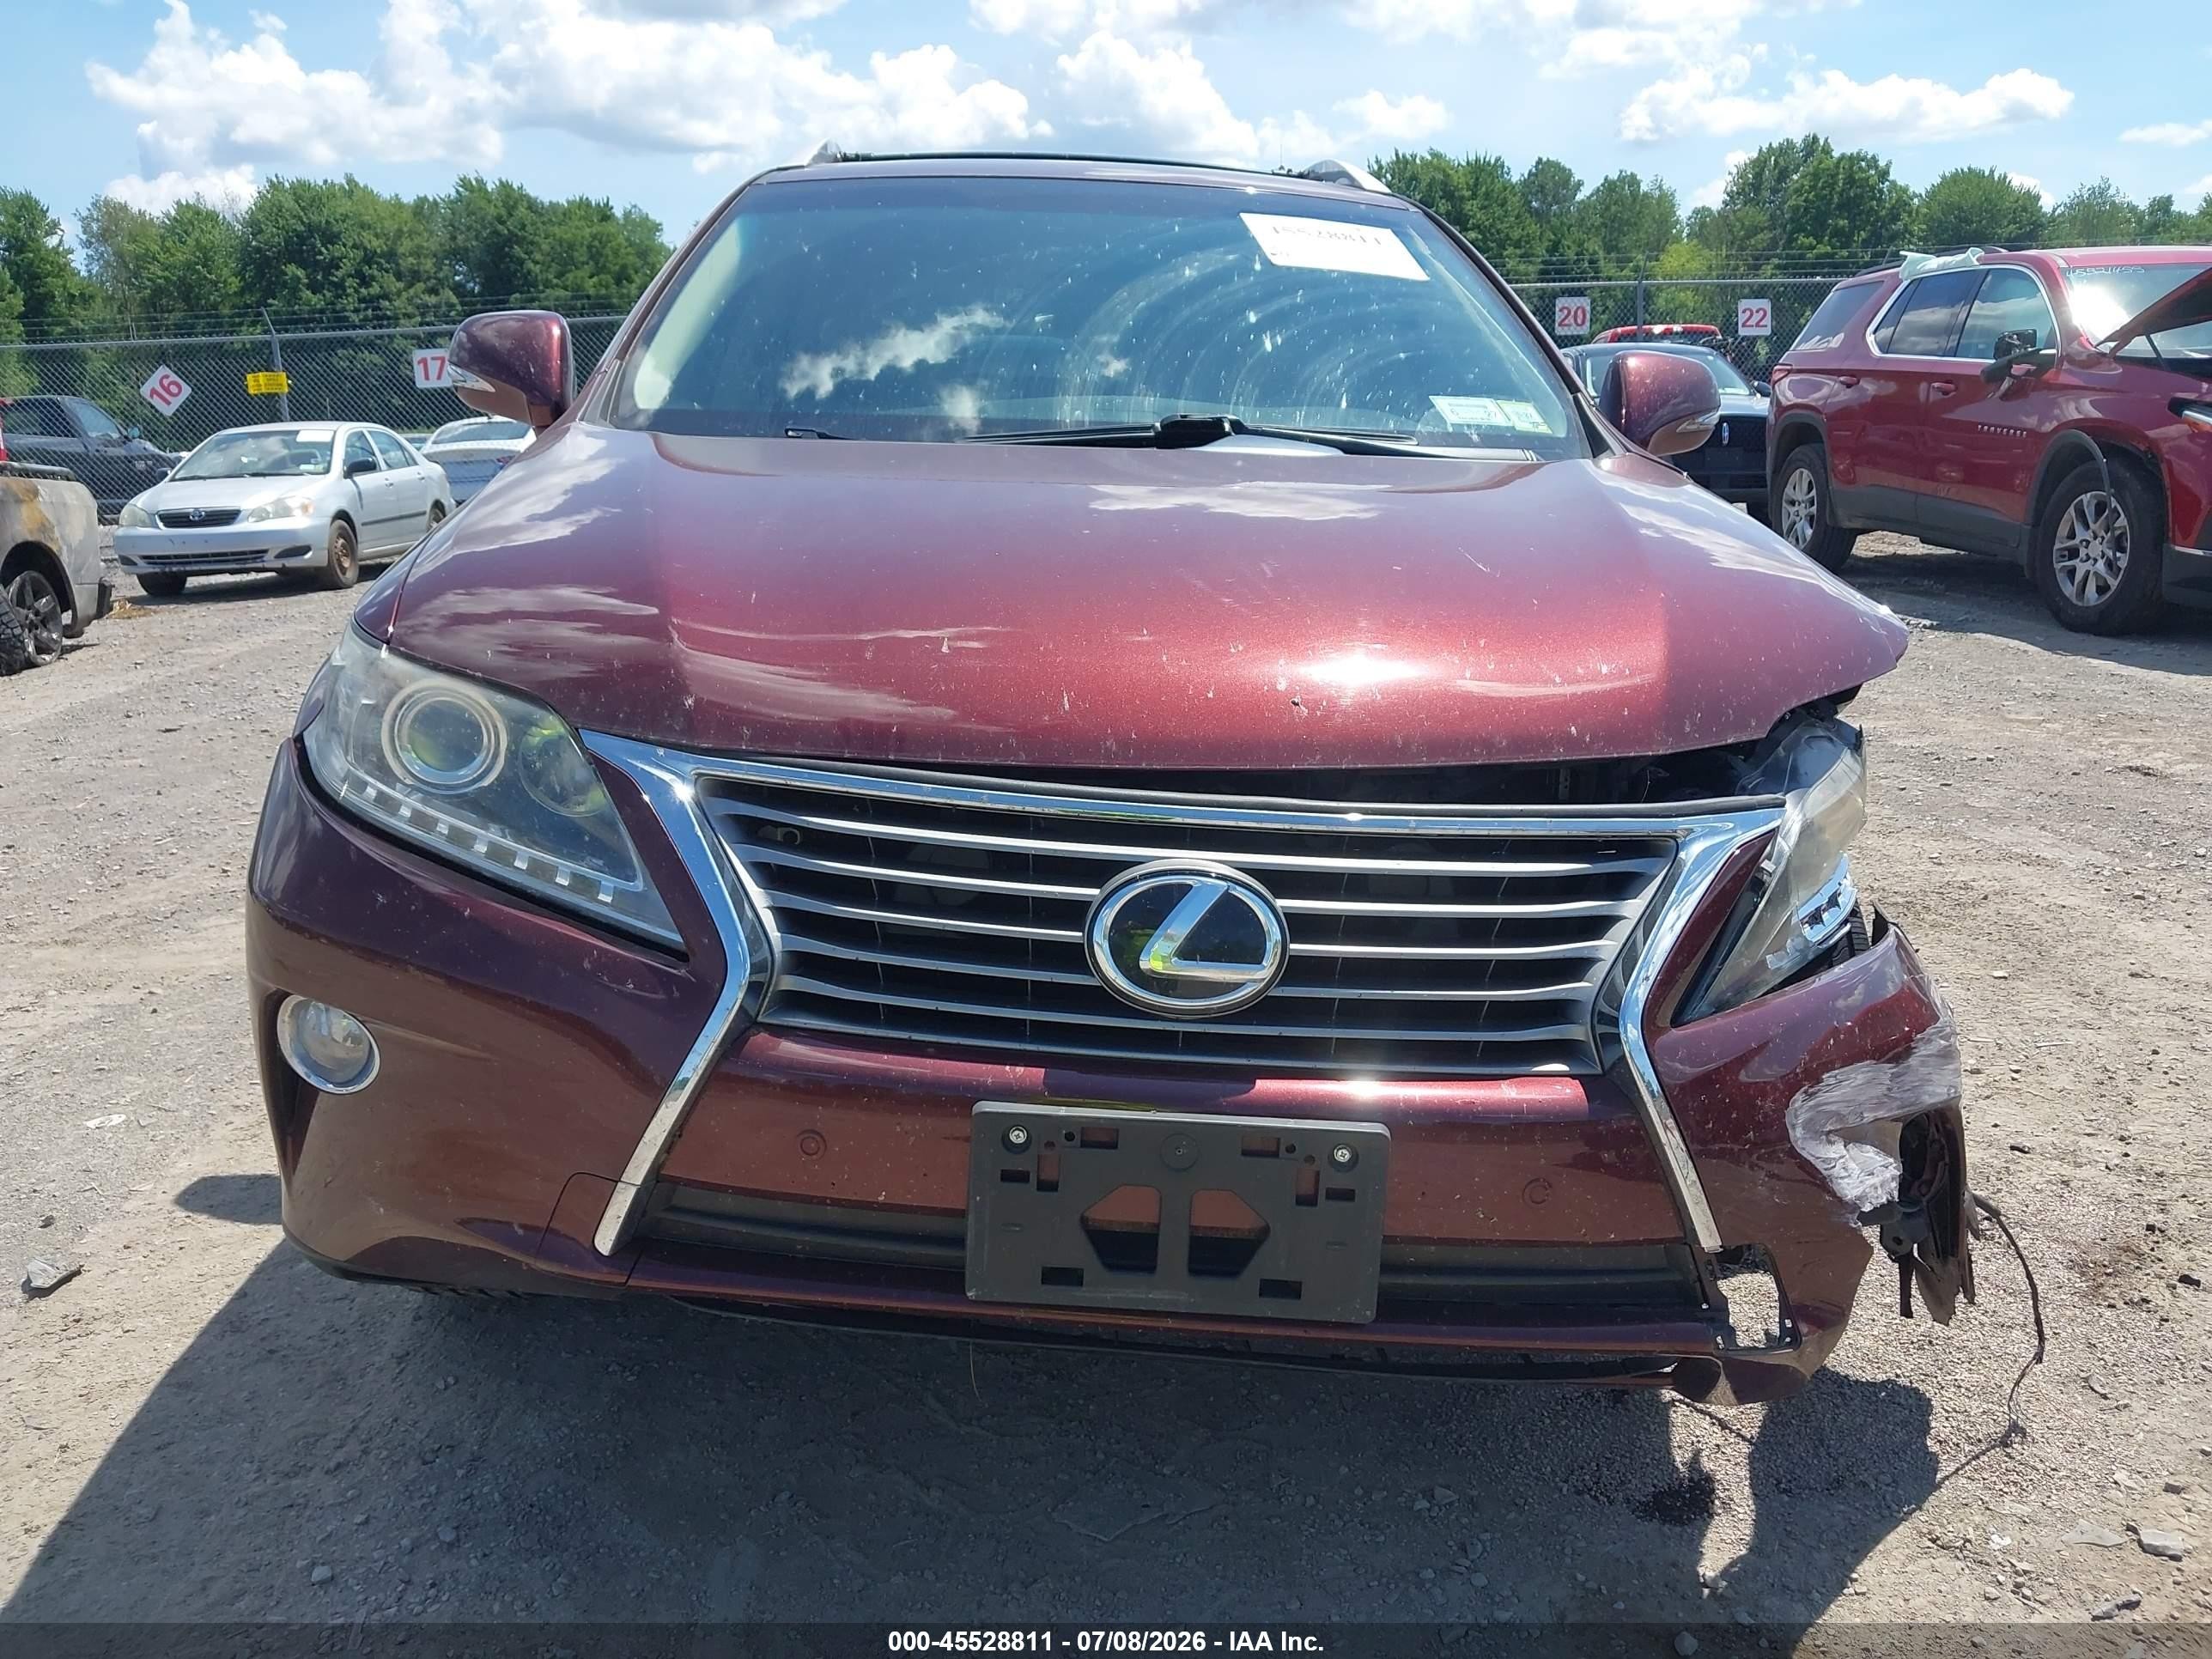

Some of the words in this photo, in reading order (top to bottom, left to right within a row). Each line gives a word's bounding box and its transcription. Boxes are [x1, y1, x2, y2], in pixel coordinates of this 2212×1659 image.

[1558, 306, 1586, 327] 20
[1741, 307, 1768, 328] 22
[417, 356, 446, 380] 17
[149, 374, 183, 406] 16
[1978, 424, 2027, 438] TRAVERSE
